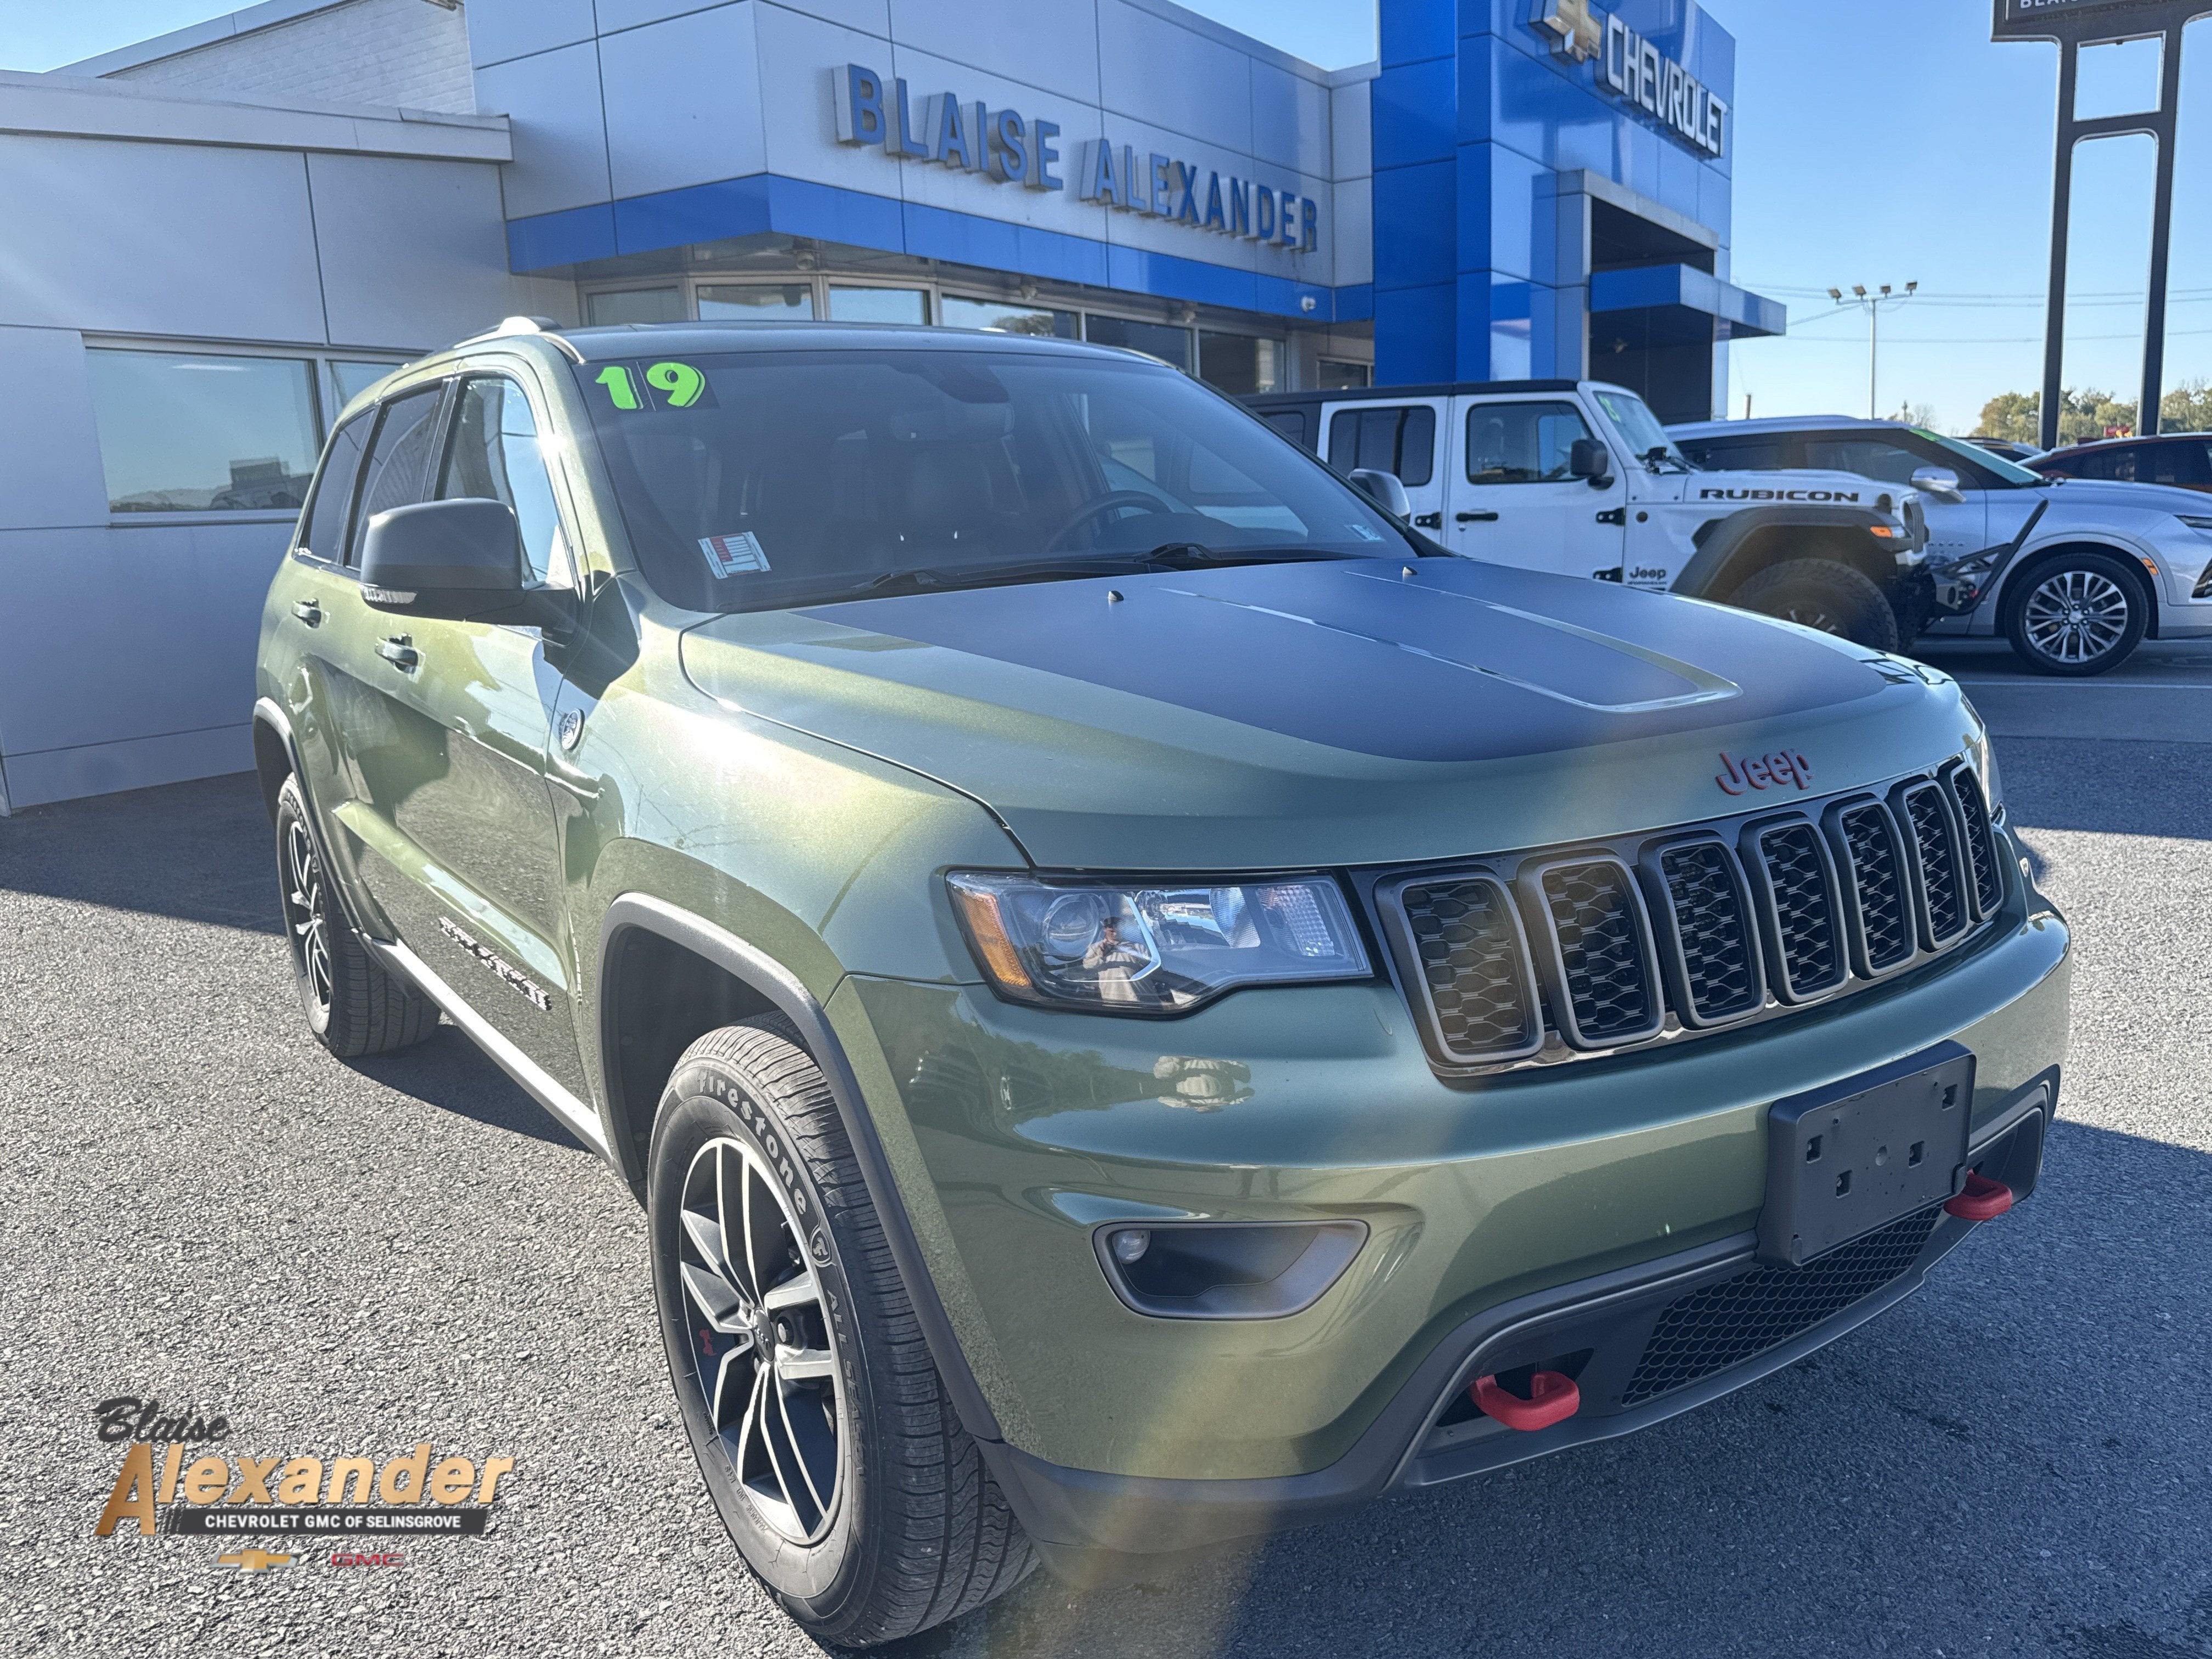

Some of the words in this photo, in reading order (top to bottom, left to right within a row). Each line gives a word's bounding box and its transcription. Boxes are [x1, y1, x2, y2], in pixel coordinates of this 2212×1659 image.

[1607, 13, 1727, 157] CHEVROLET
[832, 63, 1063, 191] BLAISE
[1081, 138, 1317, 252] ALEXANDER
[595, 362, 706, 409] 19
[1700, 488, 1859, 503] RUBICON
[1628, 566, 1667, 580] Jeep
[1715, 748, 1815, 795] Jeep
[827, 1289, 848, 1350] ALL
